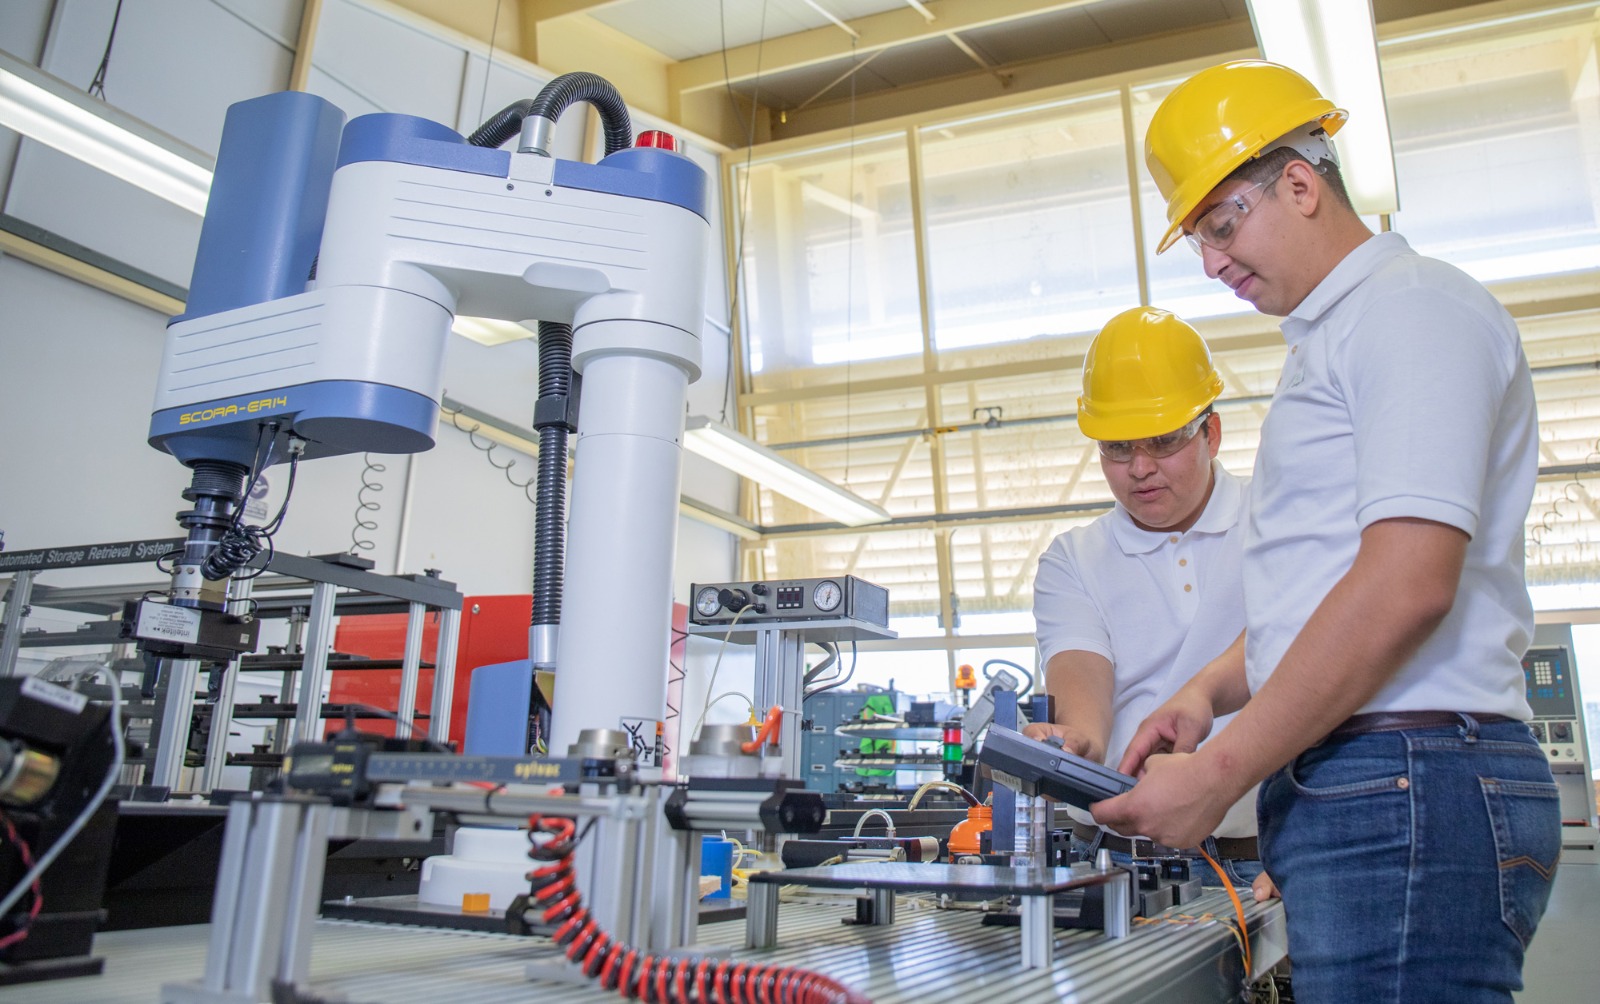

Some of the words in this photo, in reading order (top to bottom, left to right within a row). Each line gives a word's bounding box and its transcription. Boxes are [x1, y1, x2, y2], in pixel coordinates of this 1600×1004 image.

[179, 396, 288, 425] SCORA-ER14
[0, 551, 44, 566] utomated
[47, 549, 85, 564] Storage
[88, 543, 133, 560] Retrieval
[135, 542, 174, 559] System
